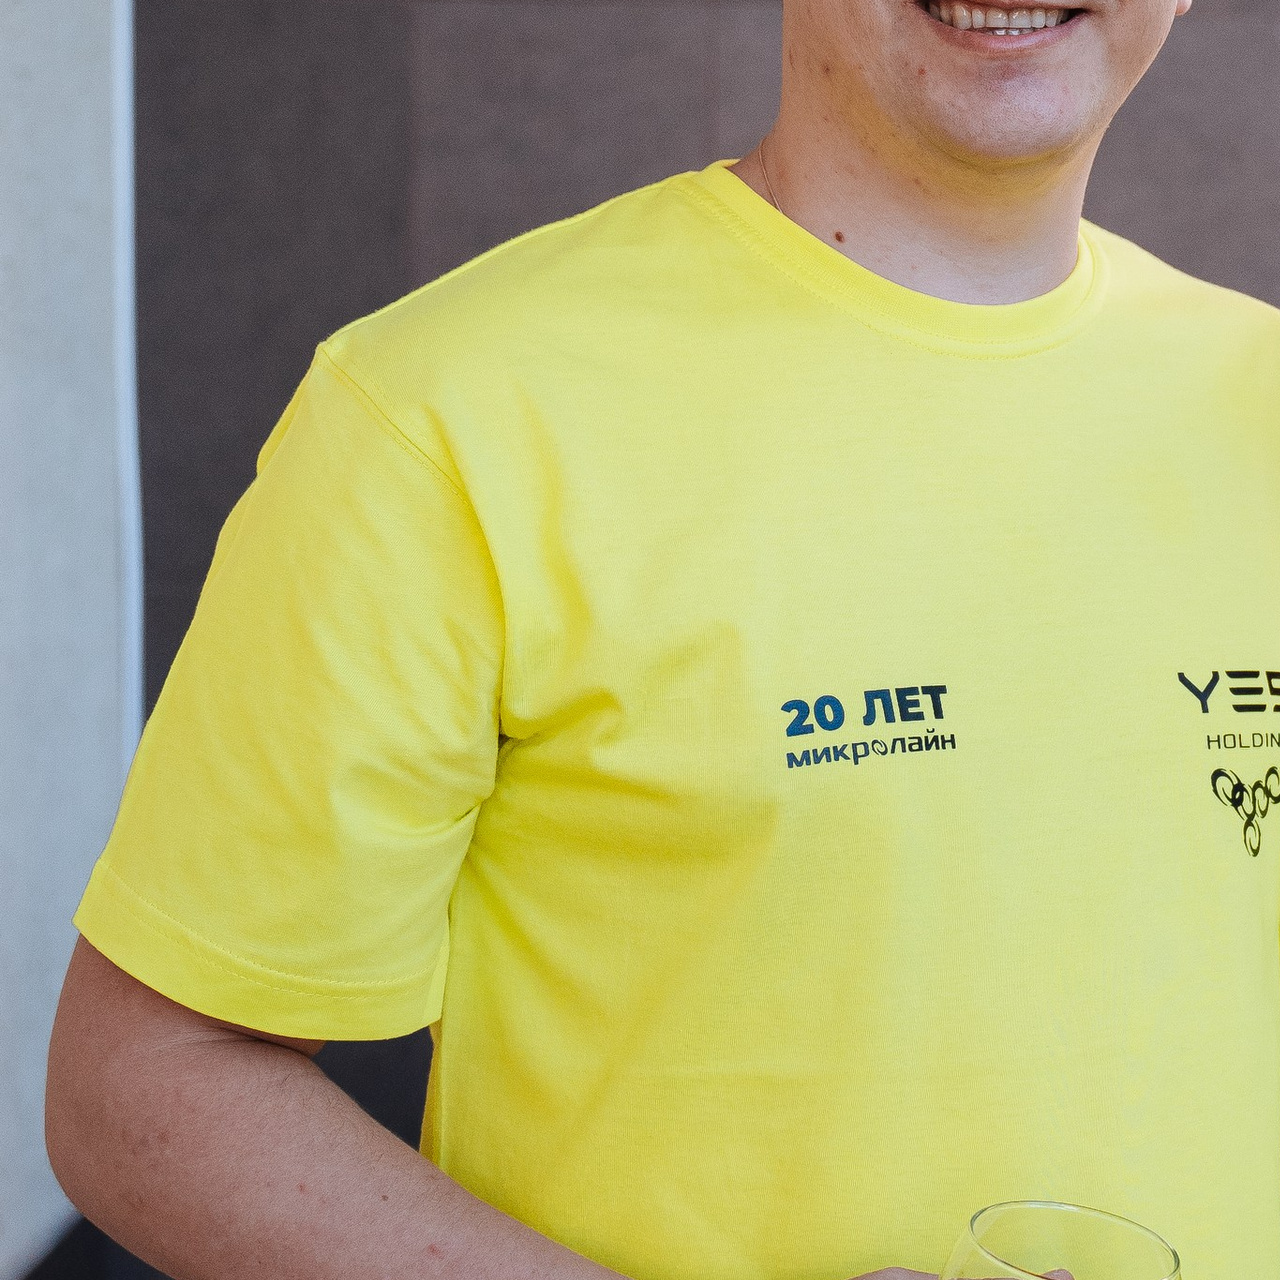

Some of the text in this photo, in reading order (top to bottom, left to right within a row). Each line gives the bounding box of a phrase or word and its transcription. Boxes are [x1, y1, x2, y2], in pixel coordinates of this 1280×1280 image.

[780, 684, 948, 738] 20 ЛЕТ
[786, 727, 957, 769] микролайн
